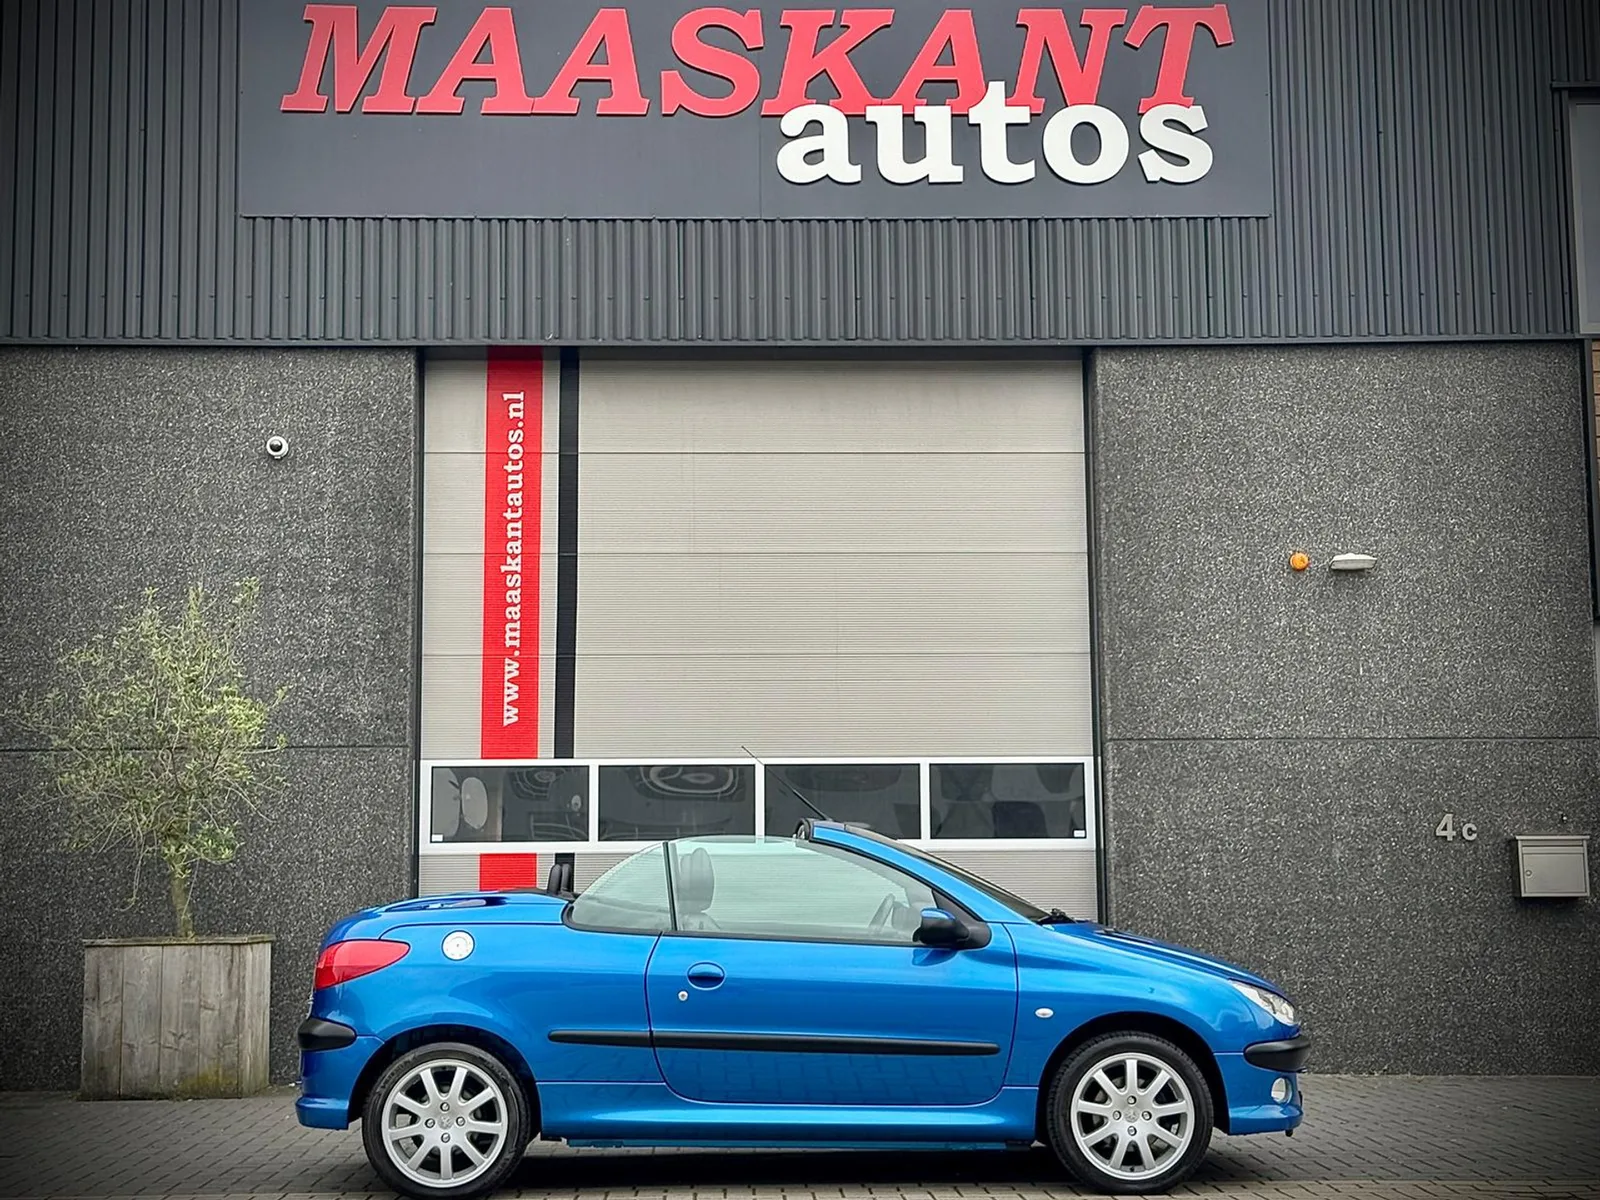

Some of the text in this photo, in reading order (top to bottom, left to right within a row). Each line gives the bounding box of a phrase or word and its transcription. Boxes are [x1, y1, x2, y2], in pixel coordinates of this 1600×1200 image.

[280, 3, 1235, 117] MAASKANT
[776, 80, 1214, 185] autos
[500, 391, 526, 727] www.maaskantautos.nl
